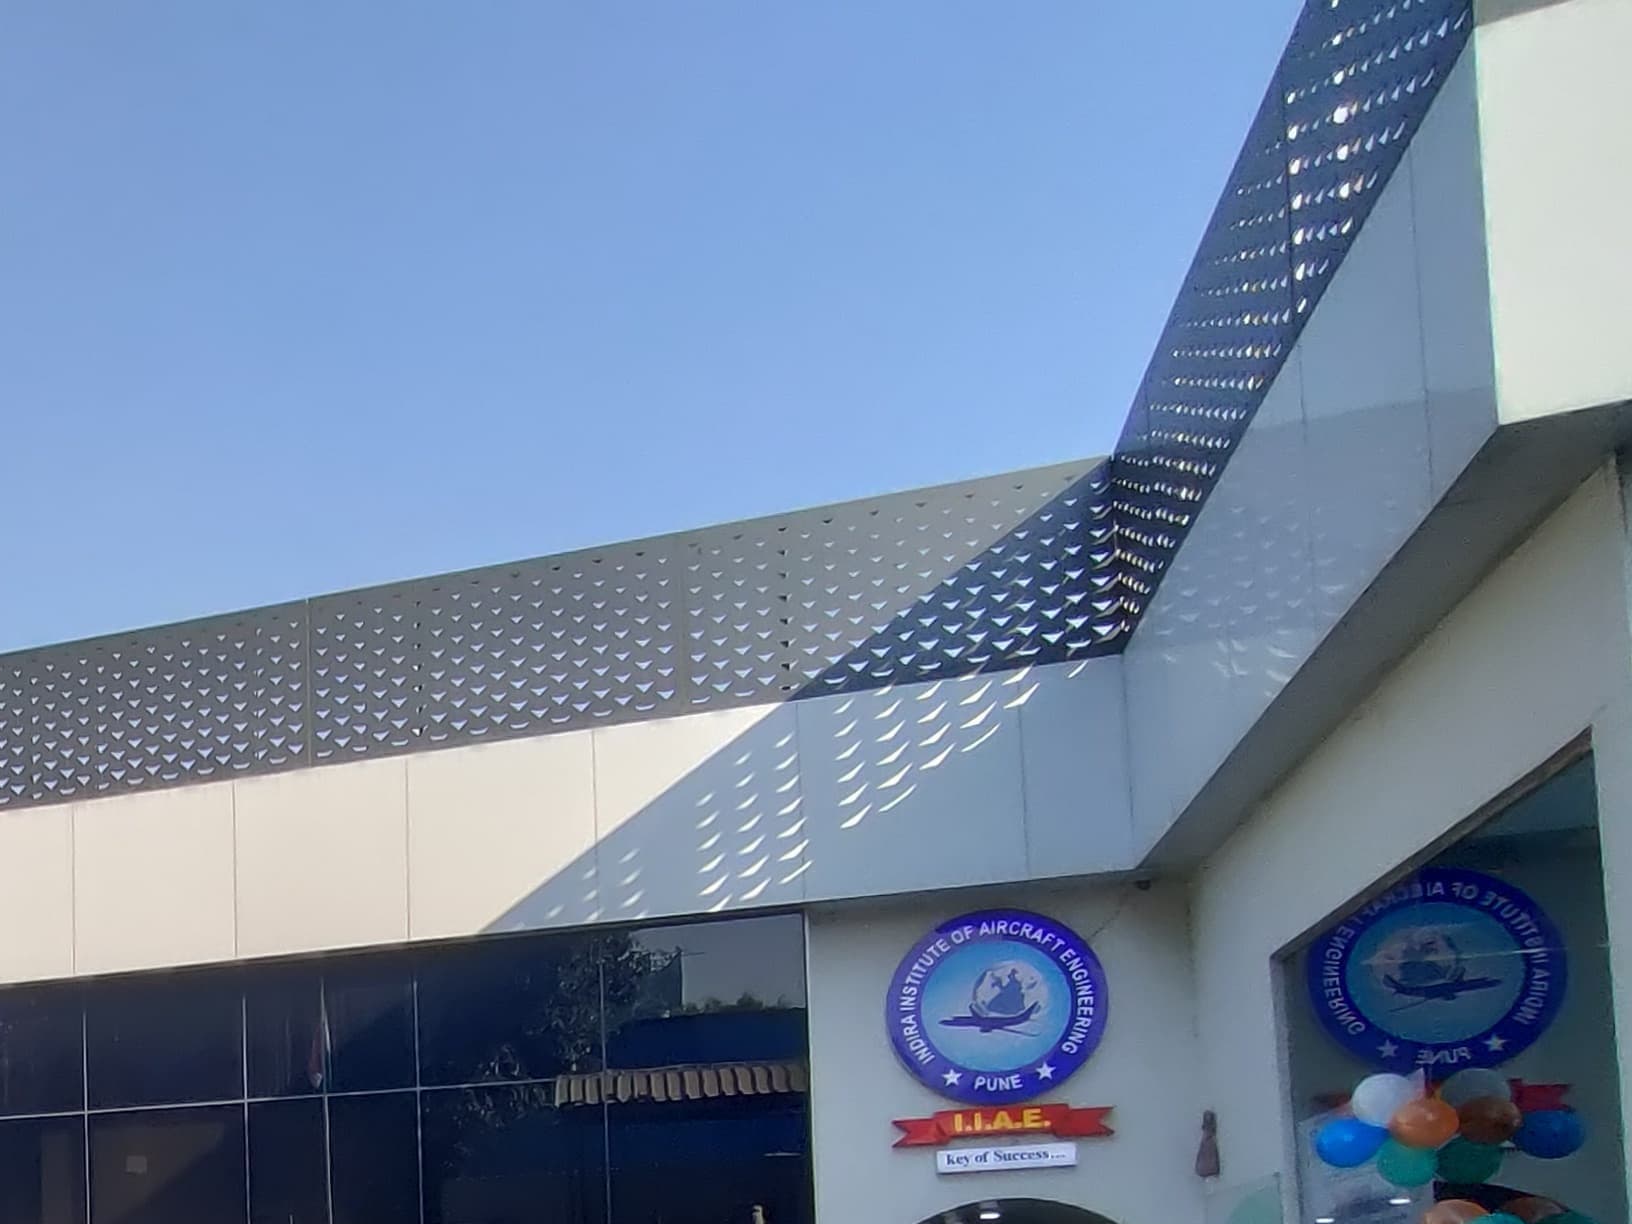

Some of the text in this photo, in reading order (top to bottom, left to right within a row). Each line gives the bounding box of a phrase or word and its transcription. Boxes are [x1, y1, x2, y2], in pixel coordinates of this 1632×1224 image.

[900, 920, 1094, 1065] INDIRA INSTITUTE OF AIRCRAFT ENGINEERING
[974, 1074, 1023, 1091] PUNE
[954, 1108, 1051, 1132] I.I.A.E.
[975, 1151, 990, 1163] of
